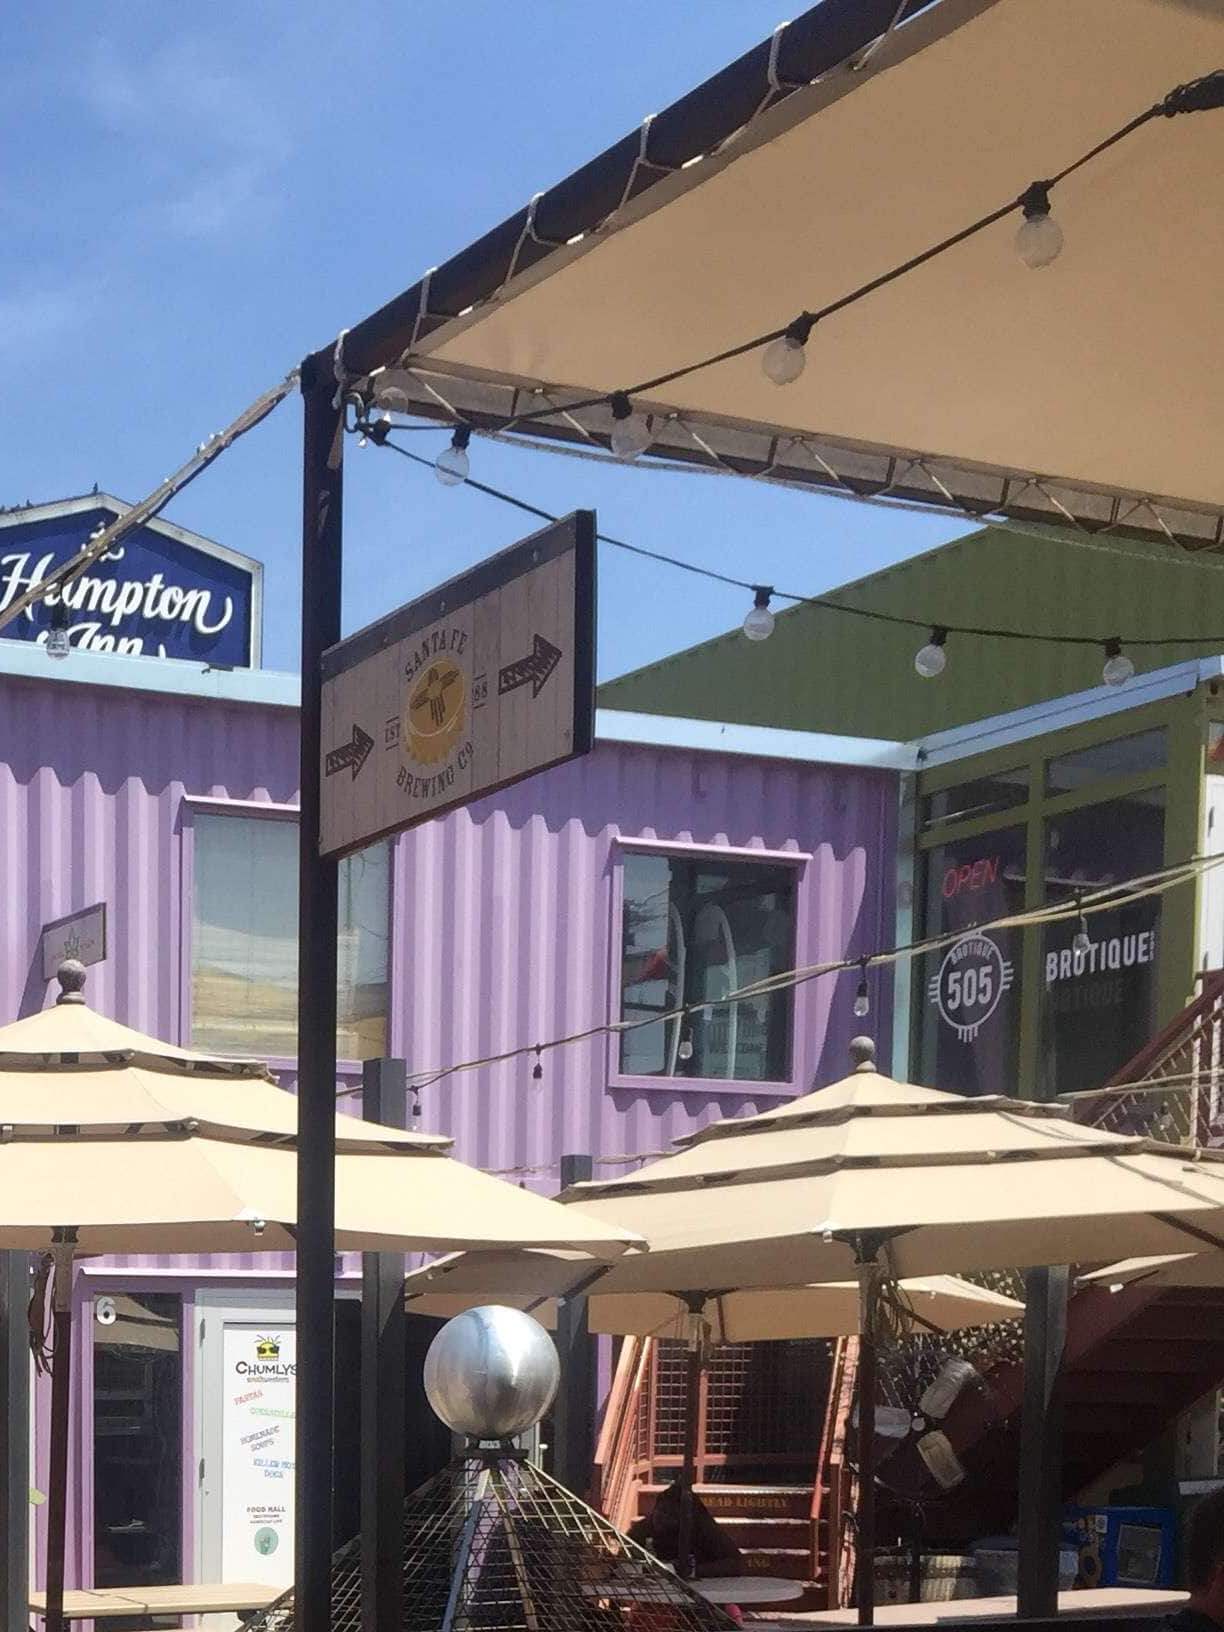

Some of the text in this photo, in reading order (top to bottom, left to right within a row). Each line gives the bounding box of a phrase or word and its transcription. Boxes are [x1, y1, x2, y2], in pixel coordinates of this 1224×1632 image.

[404, 629, 468, 682] SANTA FE
[396, 765, 455, 799] BREWING
[943, 856, 1001, 897] OPEN
[1046, 931, 1150, 982] BROTIQUE
[947, 965, 993, 1011] 505
[96, 1296, 117, 1325] 6
